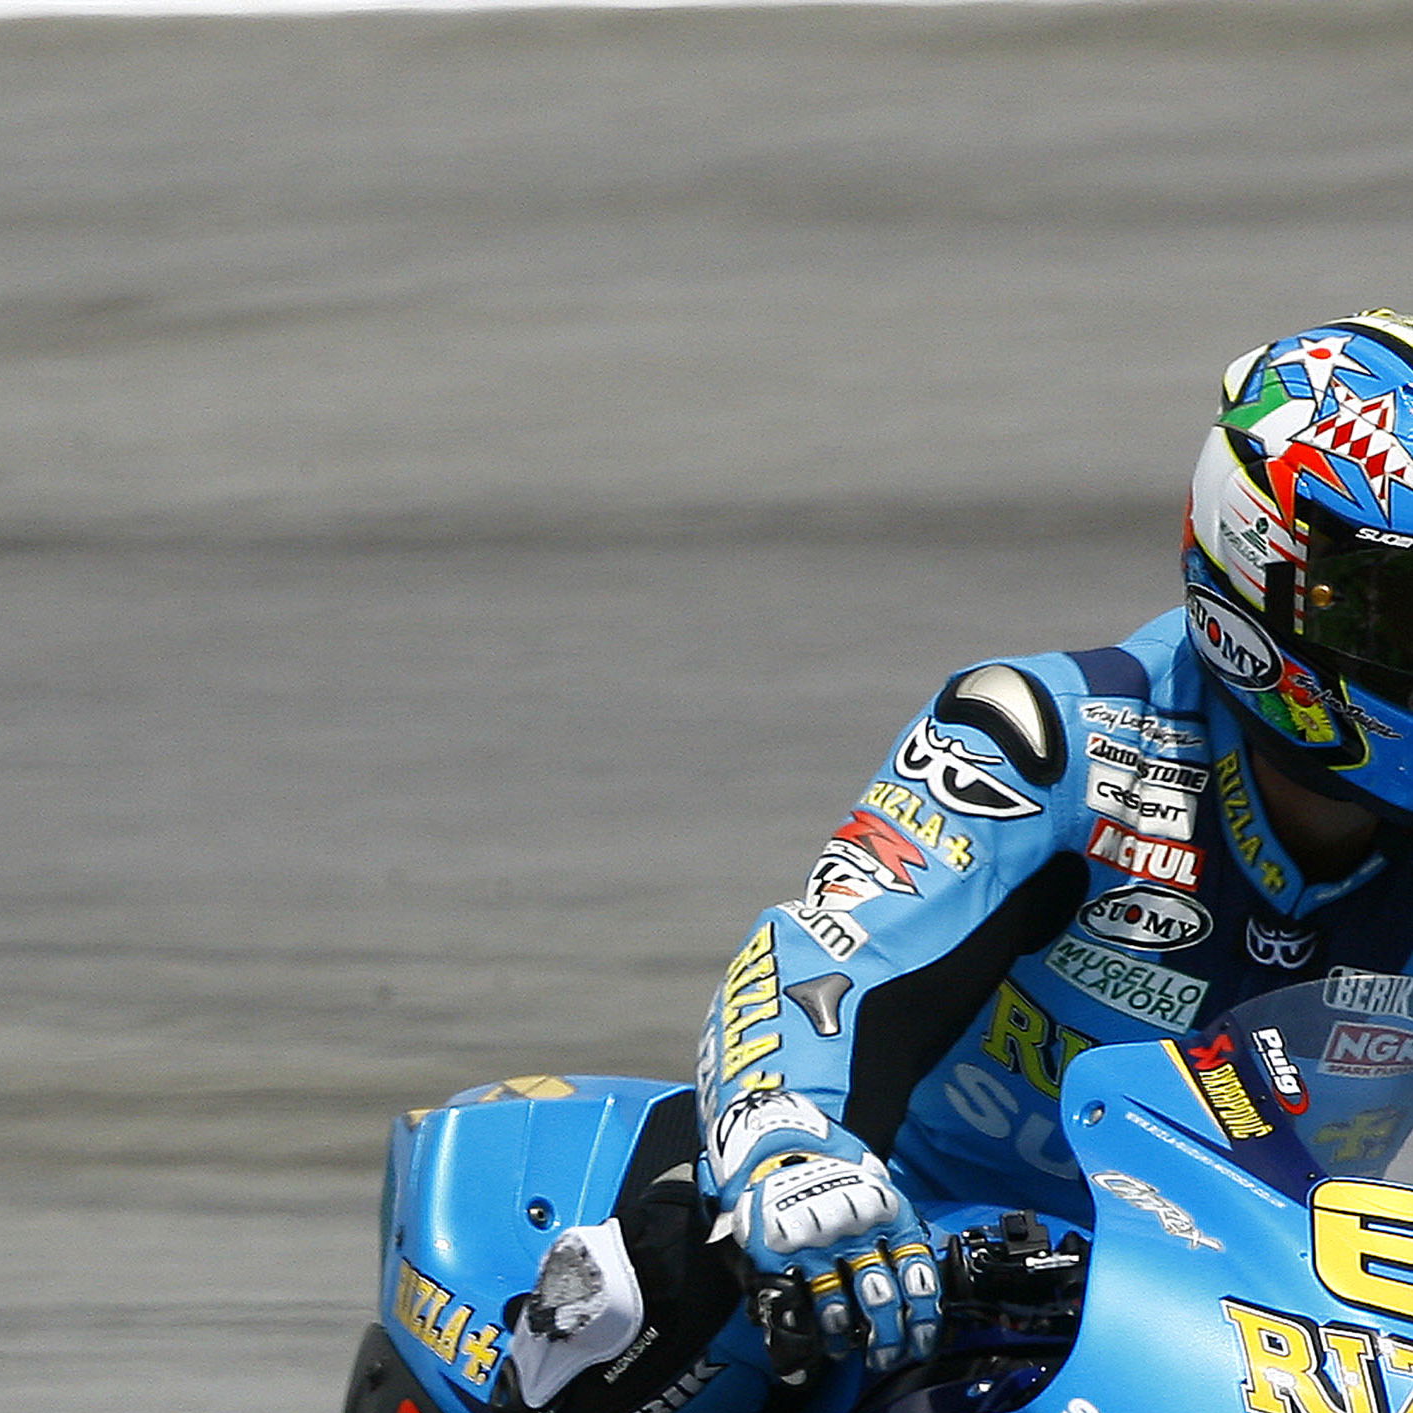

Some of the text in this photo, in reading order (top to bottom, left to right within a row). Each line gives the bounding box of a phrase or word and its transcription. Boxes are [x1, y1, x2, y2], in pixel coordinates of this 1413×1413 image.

[1091, 825, 1197, 886] MOTUL
[1091, 901, 1198, 940] SUOMY
[1056, 942, 1201, 1005] MUGELLO
[1071, 966, 1187, 1026] LAVORI
[1334, 977, 1413, 1015] BERIK
[1256, 1027, 1302, 1095] Puig
